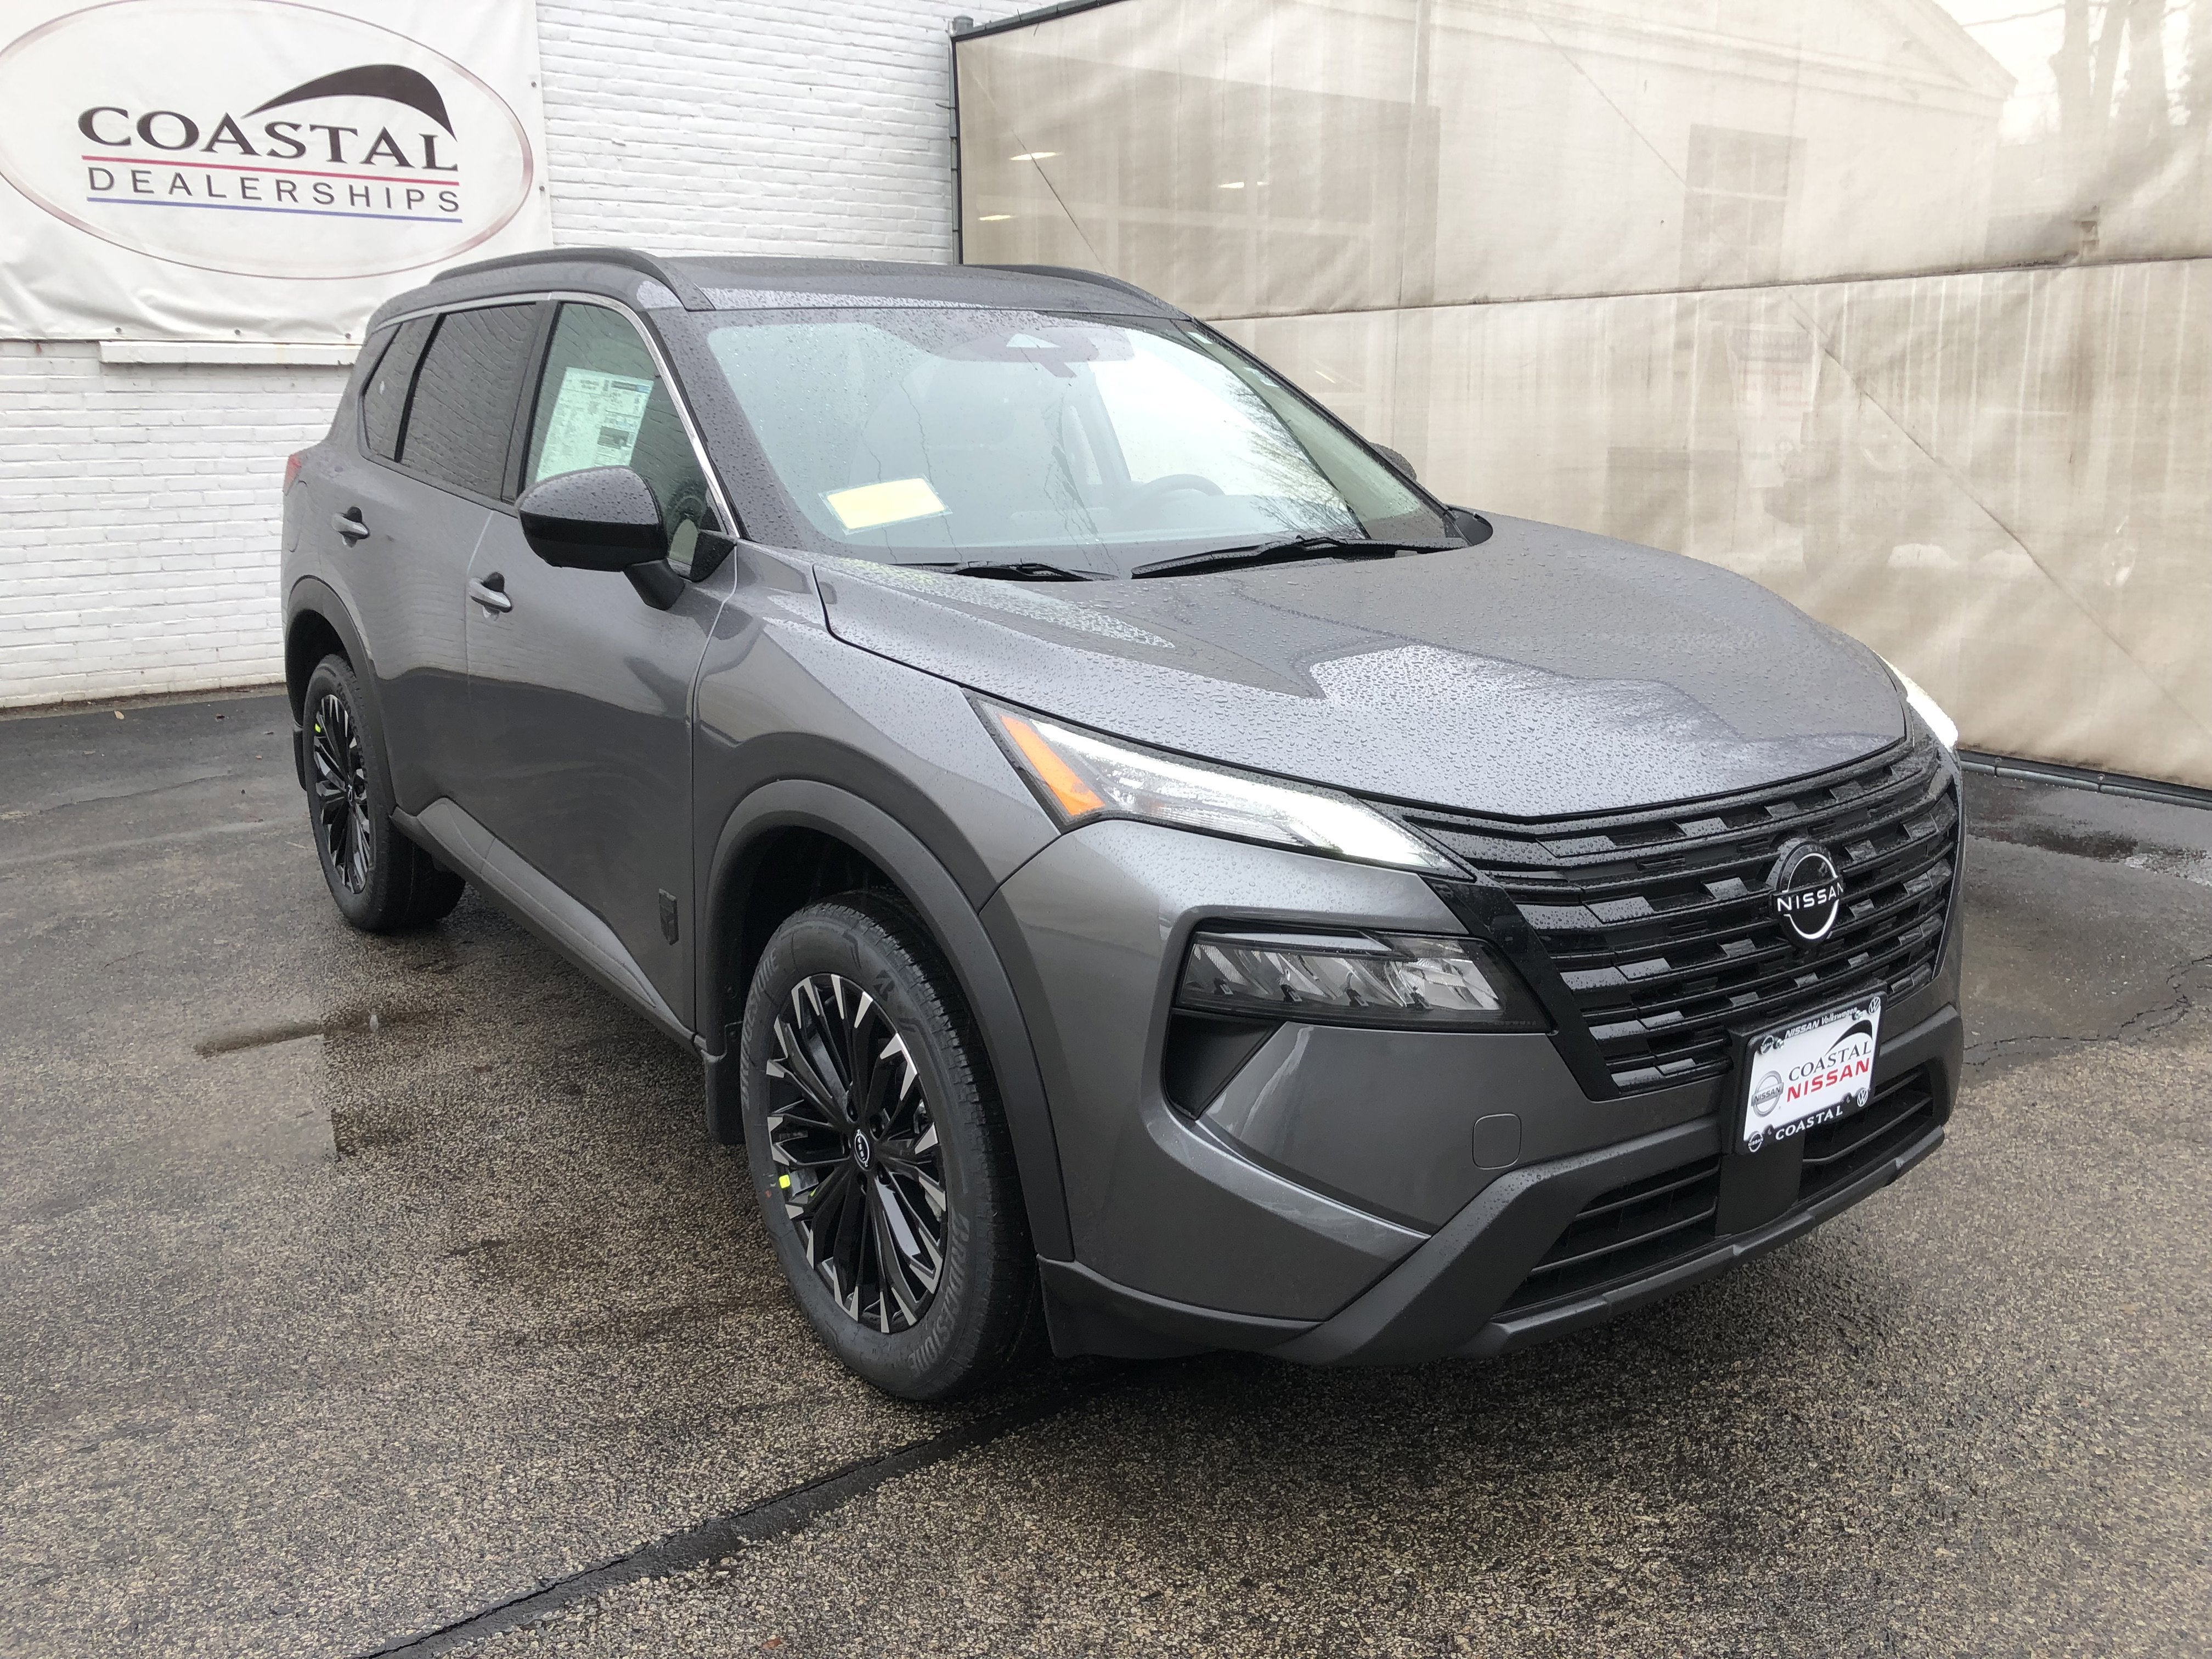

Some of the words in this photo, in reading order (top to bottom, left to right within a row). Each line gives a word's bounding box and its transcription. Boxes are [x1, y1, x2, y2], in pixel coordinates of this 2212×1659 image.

[77, 105, 459, 172] COASTAL
[87, 166, 460, 213] DEALERSHIPS
[1777, 882, 1843, 912] NISSAN
[1785, 1019, 1820, 1039] NISSAN
[1821, 1007, 1858, 1026] Volkswagen
[1786, 1057, 1870, 1103] NISSAN
[1788, 1041, 1872, 1081] COASTAL
[1754, 1086, 1781, 1104] NISSAN
[1775, 1105, 1843, 1141] COASTAL
